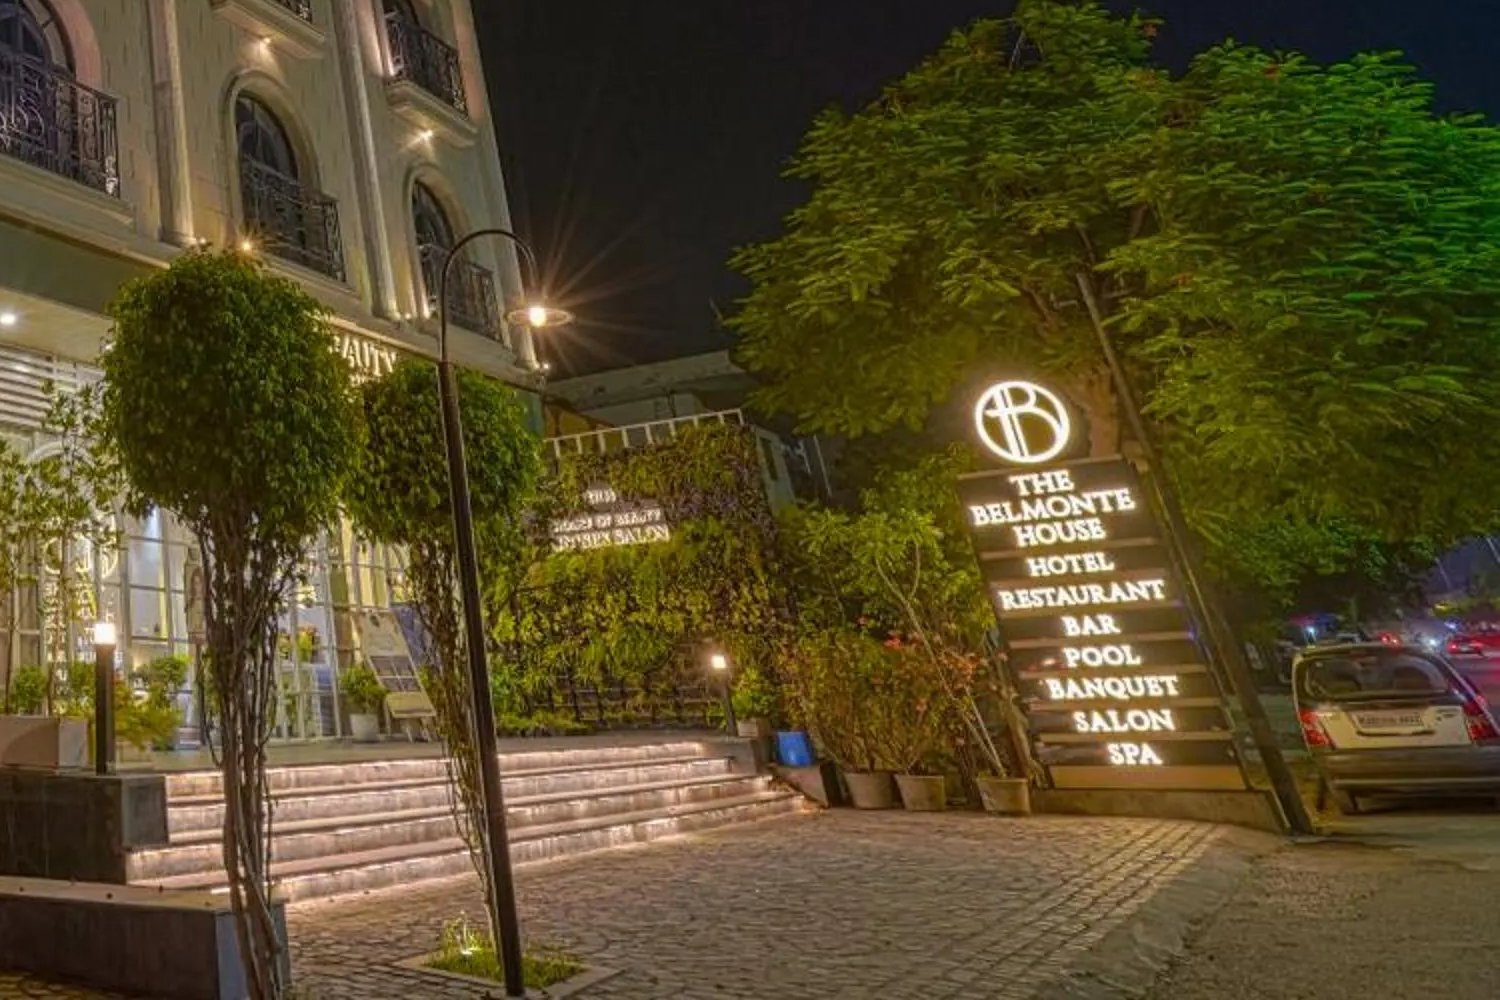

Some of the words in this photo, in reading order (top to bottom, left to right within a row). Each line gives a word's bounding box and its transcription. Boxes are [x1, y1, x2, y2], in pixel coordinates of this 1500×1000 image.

[1009, 469, 1075, 497] THE
[969, 488, 1136, 527] BELMONTE
[1013, 517, 1107, 548] HOUSE
[1026, 551, 1115, 577] HOTEL
[999, 579, 1166, 611] RESTAURANT
[1061, 615, 1121, 637] BAR
[1062, 646, 1141, 668] POOL
[1046, 675, 1179, 699] BANQUET
[1075, 709, 1176, 733] SALON
[1107, 743, 1163, 766] SPA
